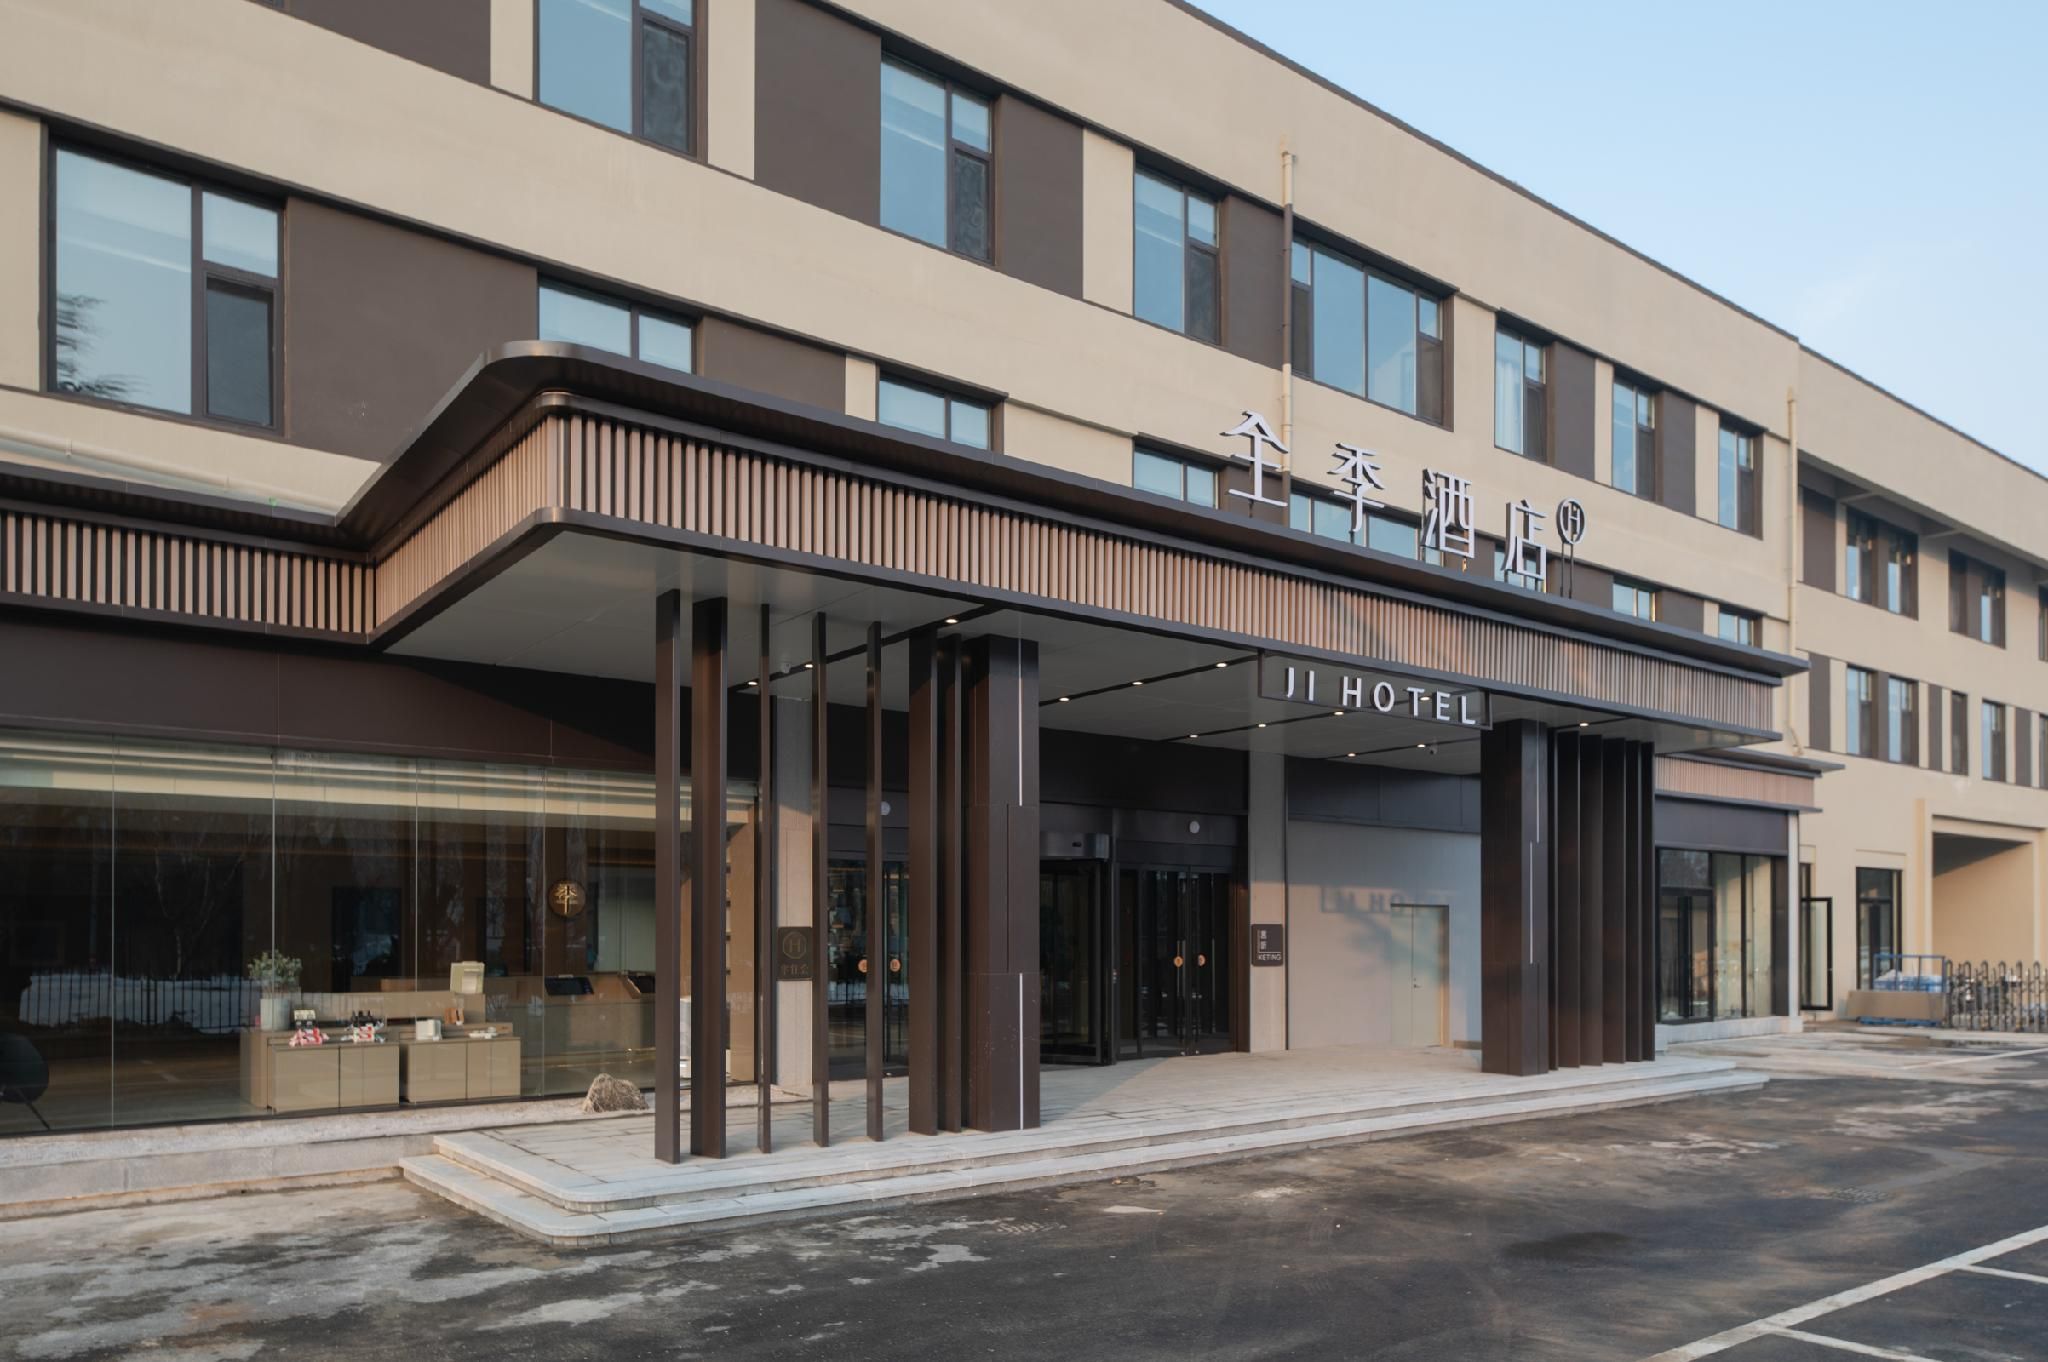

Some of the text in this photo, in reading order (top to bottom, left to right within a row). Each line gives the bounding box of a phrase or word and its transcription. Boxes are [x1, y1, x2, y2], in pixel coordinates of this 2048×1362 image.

[1220, 410, 1547, 581] 全季酒店
[1285, 667, 1476, 724] JI HOTEL
